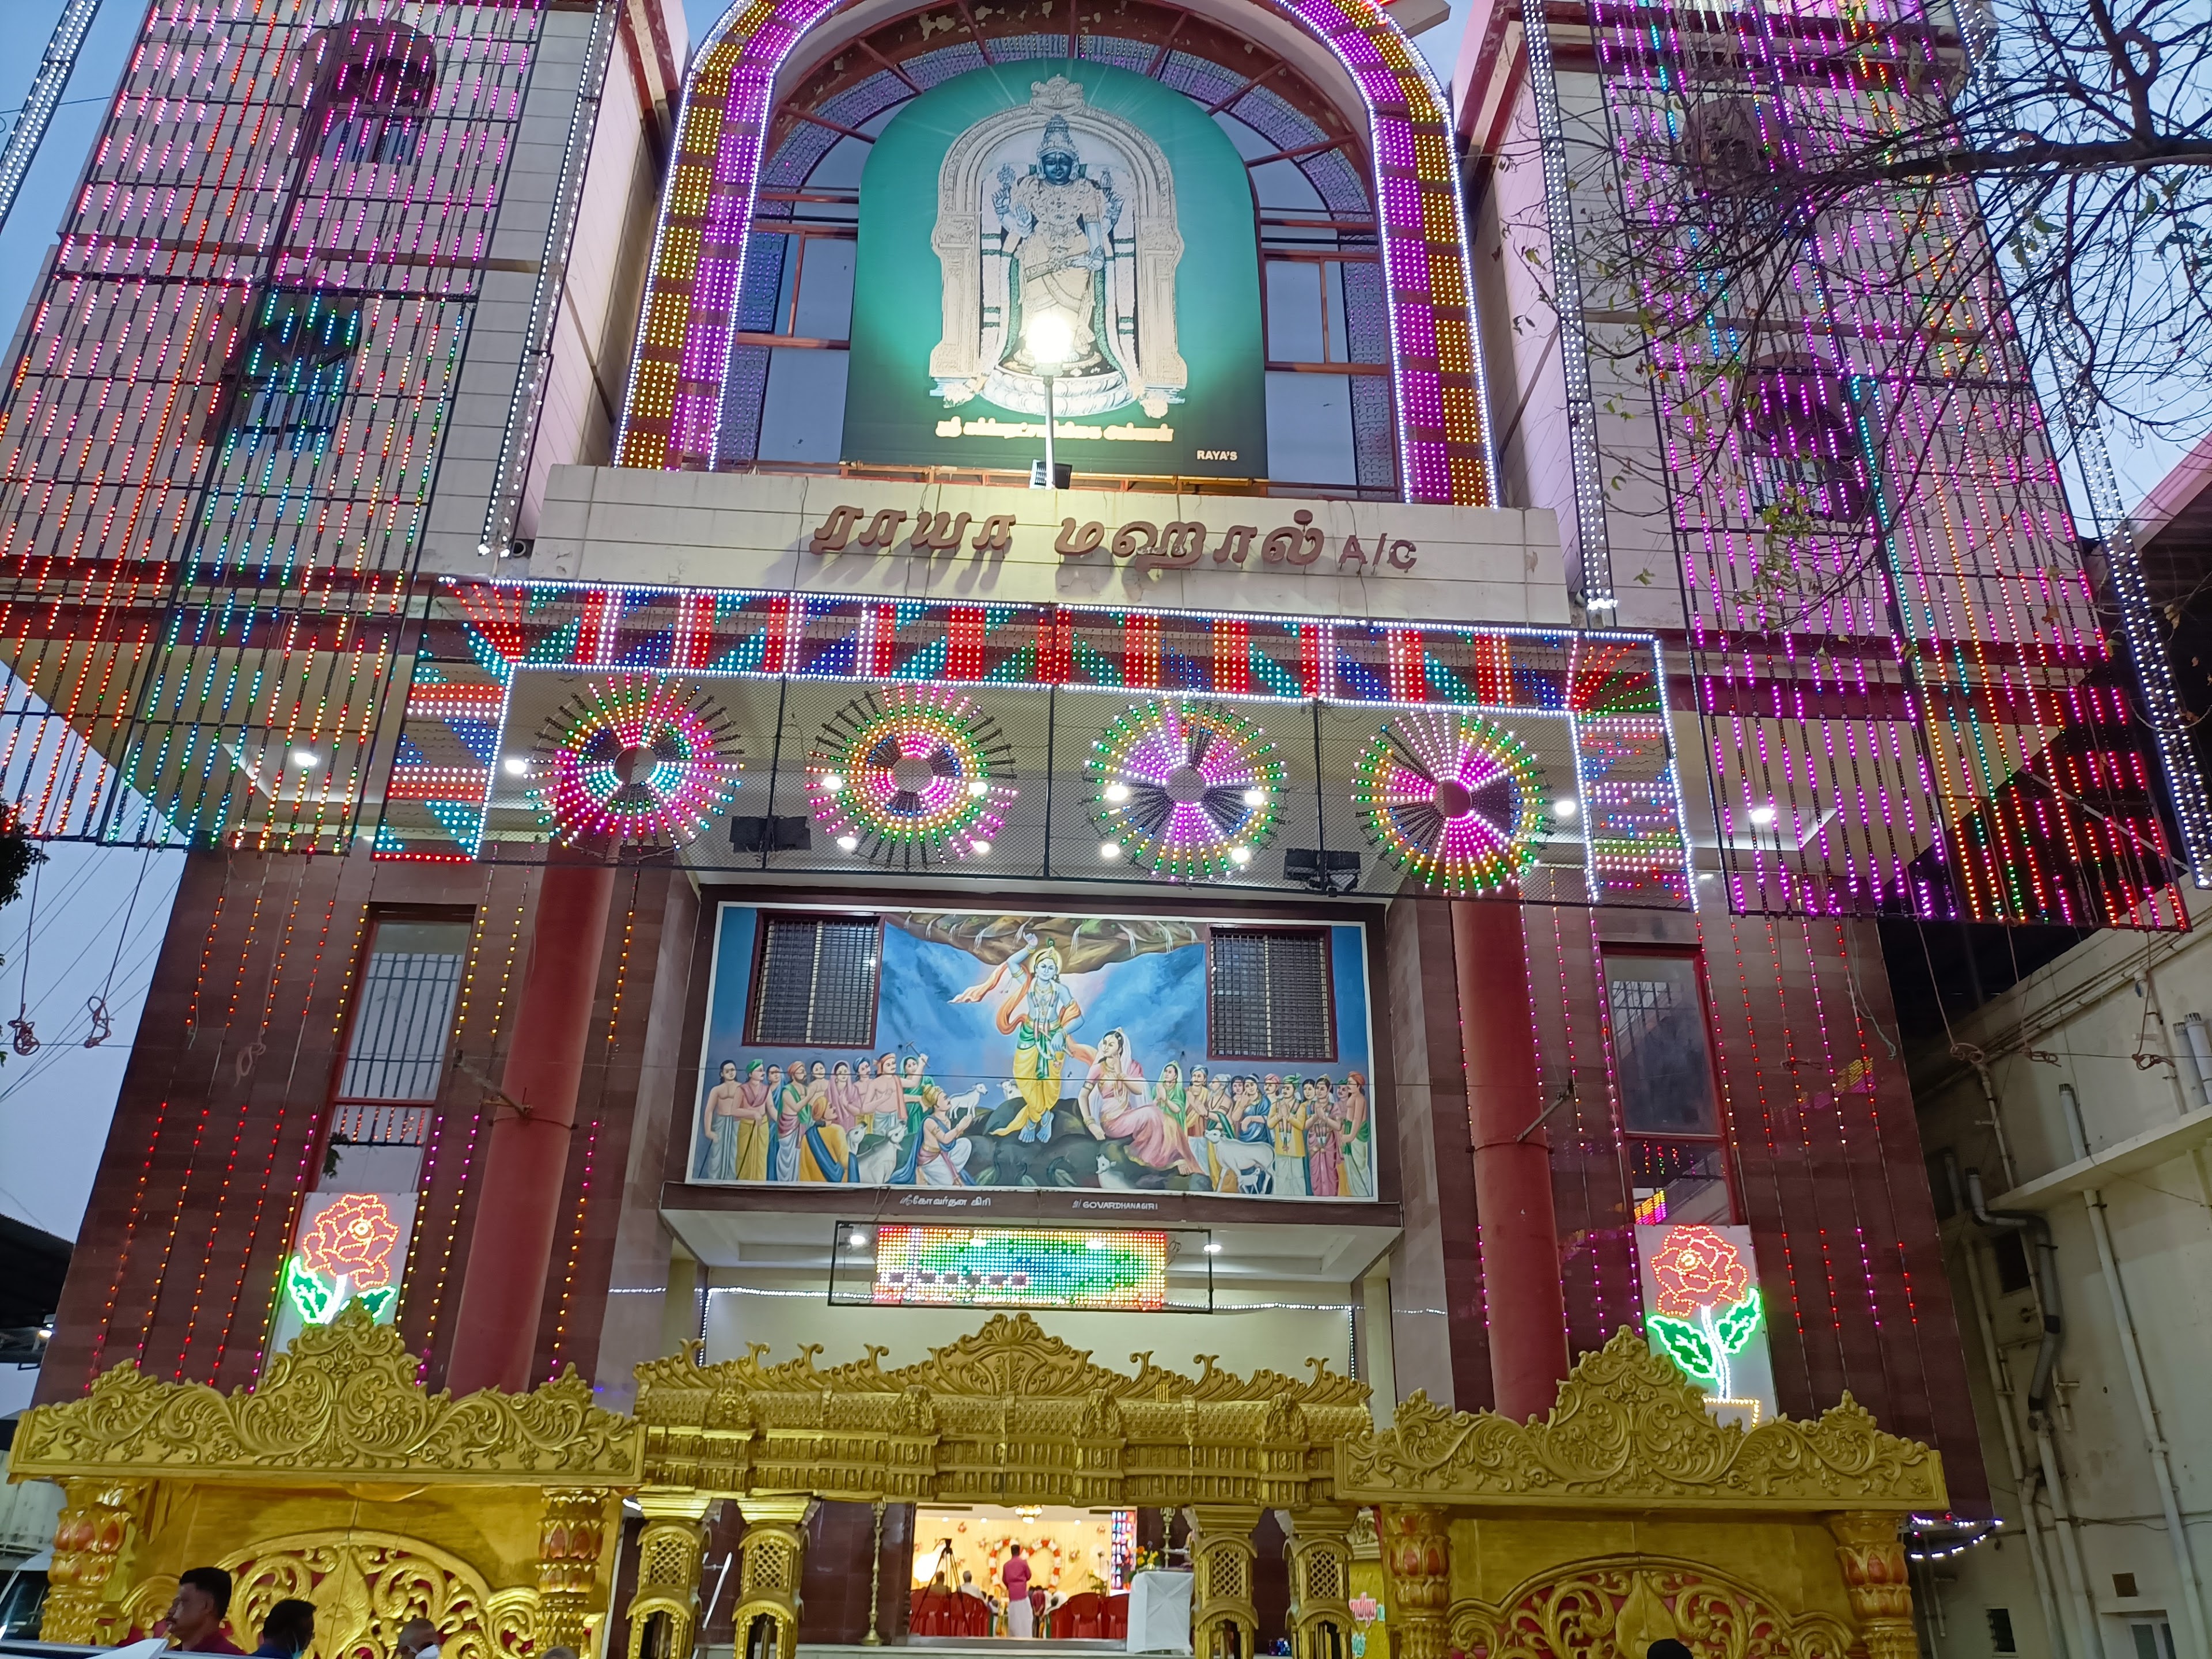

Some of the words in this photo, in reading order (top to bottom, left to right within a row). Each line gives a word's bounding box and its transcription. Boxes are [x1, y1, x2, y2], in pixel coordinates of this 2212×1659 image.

[1196, 450, 1238, 461] RAYA'S
[809, 505, 1017, 555] ராயா
[1054, 509, 1325, 573] மஹால்
[1339, 533, 1418, 570] A/C
[1082, 1201, 1158, 1210] GOVARDHANAGIRI
